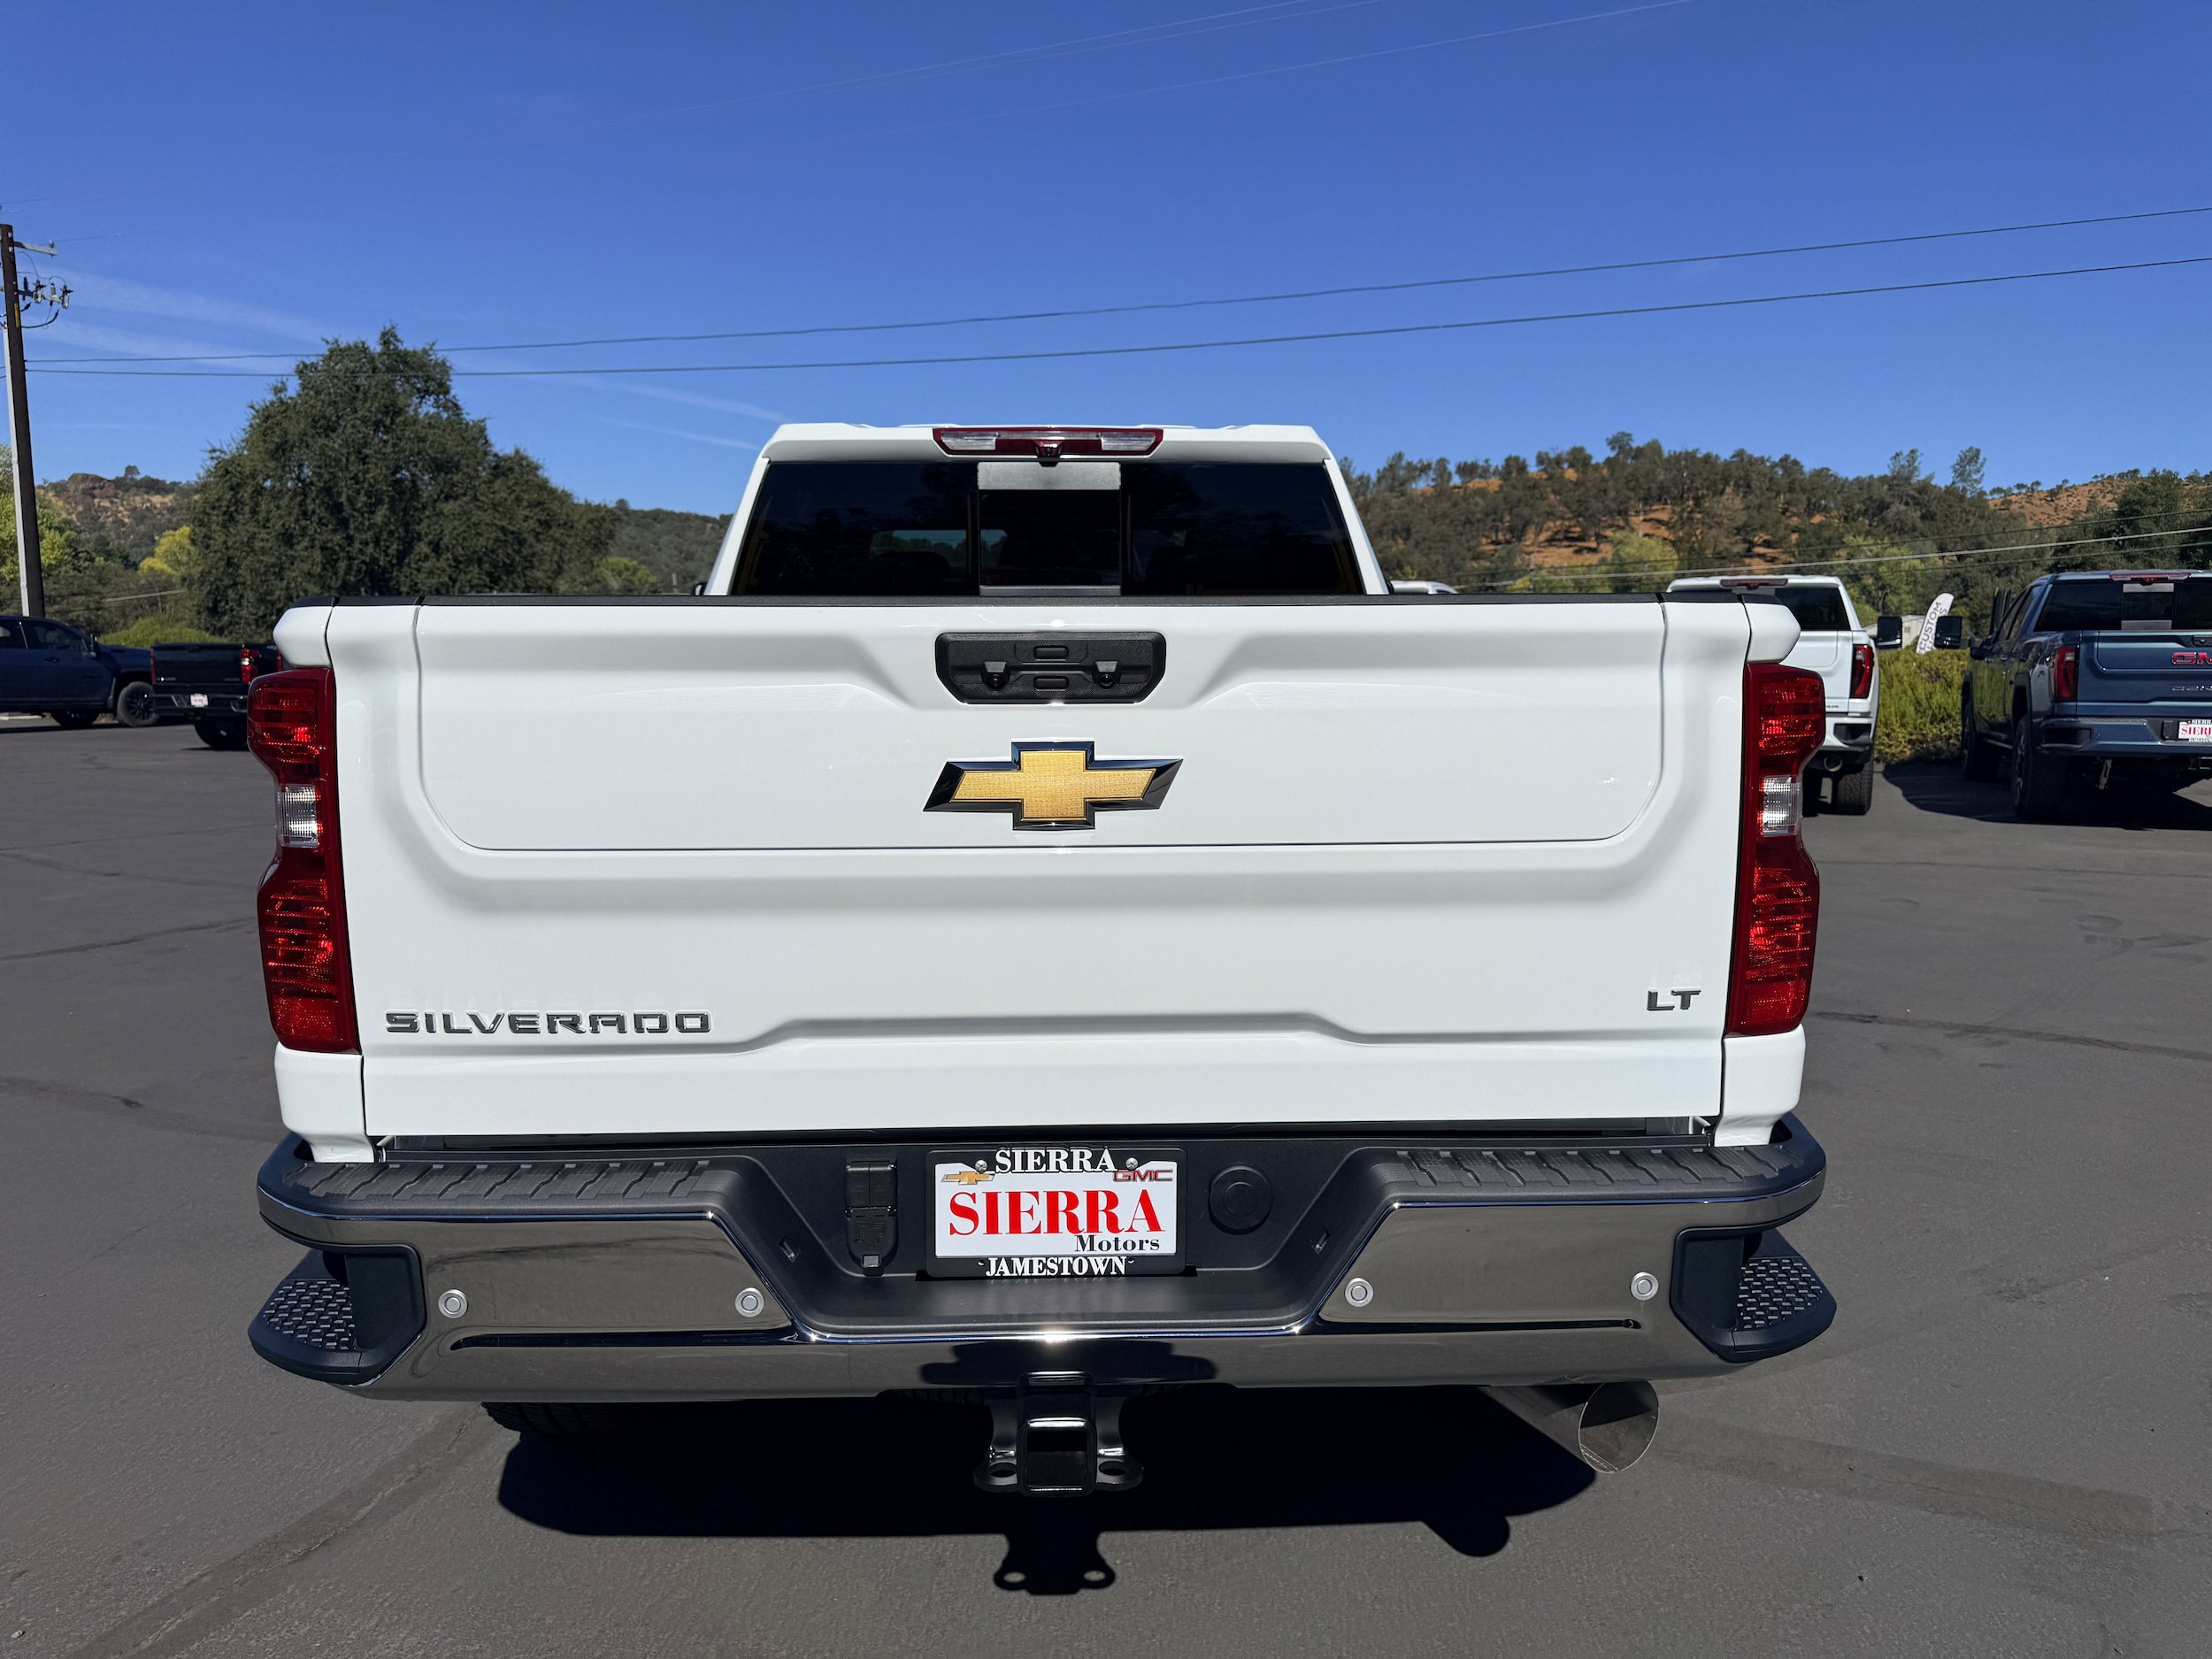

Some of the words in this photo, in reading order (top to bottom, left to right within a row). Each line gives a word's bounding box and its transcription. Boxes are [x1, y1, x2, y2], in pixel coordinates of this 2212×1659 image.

[1919, 602, 1941, 650] CUSTOM
[1647, 987, 1701, 1010] LT
[386, 1012, 712, 1033] SILVERADO
[995, 1148, 1118, 1173] SIERRA
[1112, 1168, 1173, 1182] GMC
[949, 1189, 1166, 1236] SIERRA
[1074, 1234, 1160, 1252] Motors
[986, 1256, 1127, 1277] JAMESTOWN
